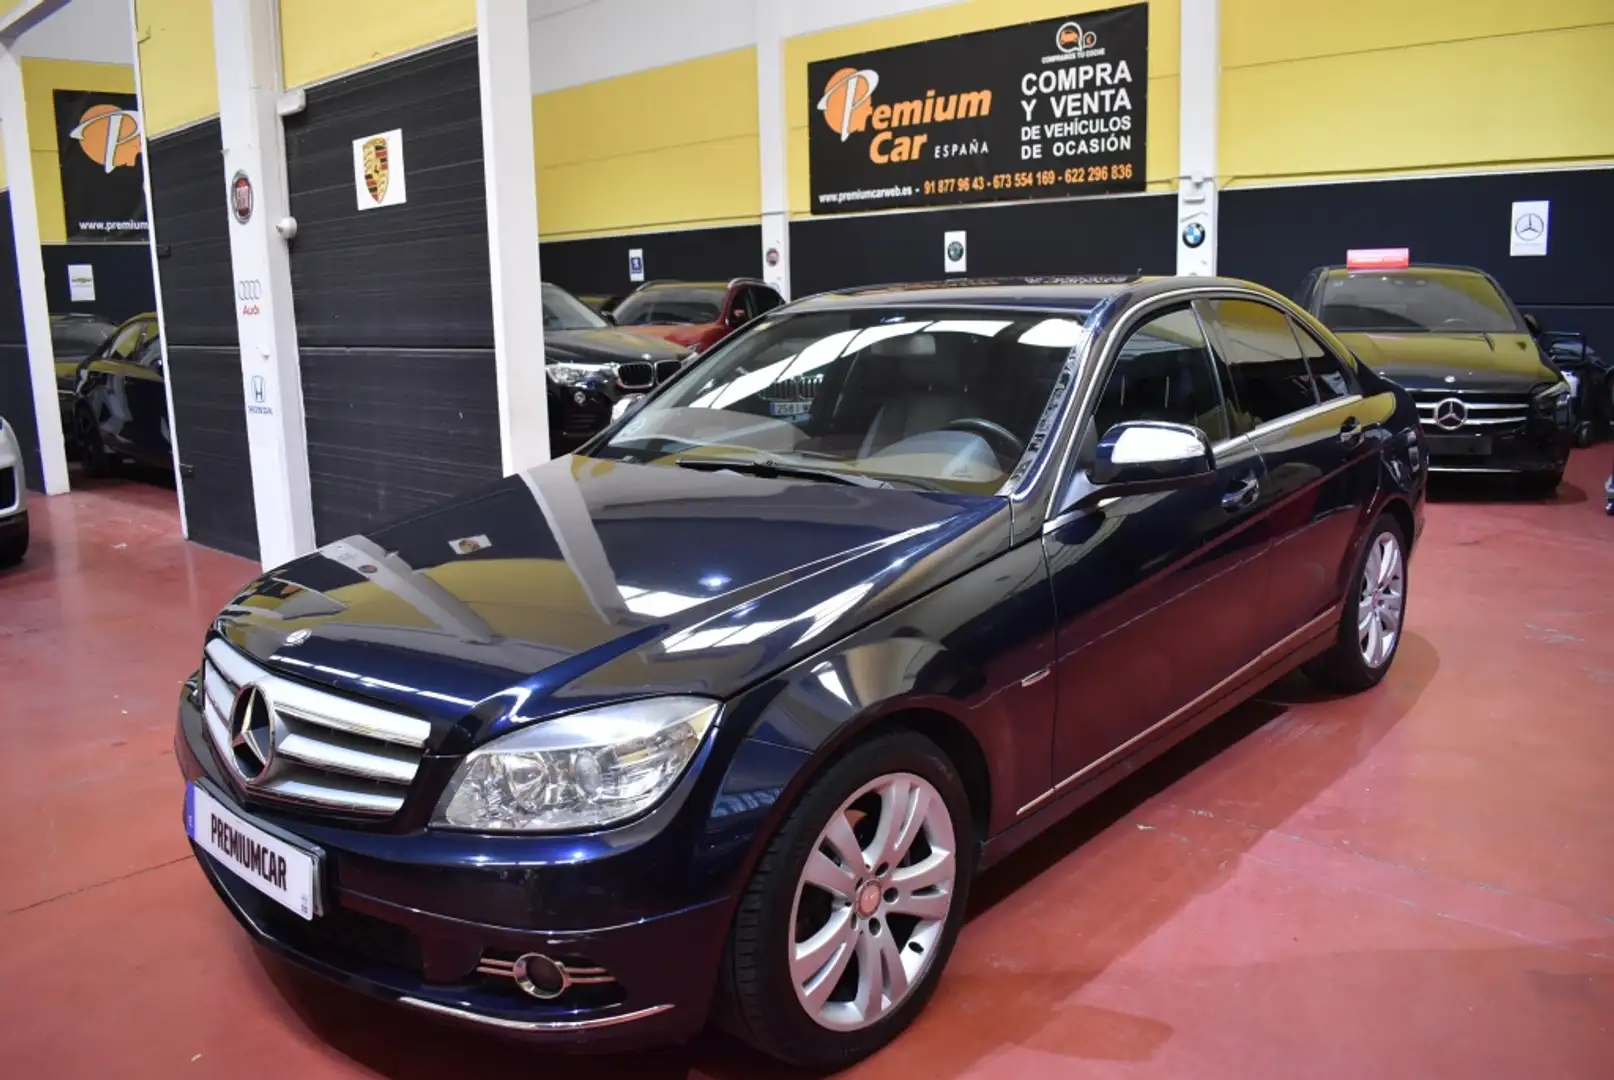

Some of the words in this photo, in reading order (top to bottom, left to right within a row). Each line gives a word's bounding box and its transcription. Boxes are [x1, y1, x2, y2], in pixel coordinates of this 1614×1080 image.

[1021, 60, 1133, 96] COMPRA
[817, 69, 992, 142] Premium
[1020, 98, 1037, 122] Y
[1050, 87, 1132, 118] VENTA
[1021, 125, 1041, 141] DE
[1044, 115, 1132, 138] VEHÍCULOS
[869, 131, 928, 165] Car
[934, 138, 989, 159] ESPAÑA
[1021, 143, 1042, 160] DE
[1052, 133, 1131, 157] OCASIÓN
[818, 185, 912, 204] www.premiumcarweb.es
[923, 180, 936, 195] 91
[938, 178, 955, 193] 877
[971, 175, 985, 190] 43
[992, 173, 1012, 189] 673
[1014, 171, 1033, 187] 554
[1036, 169, 1056, 185] 169
[1064, 167, 1084, 183] 622
[1087, 165, 1108, 182] 296
[1111, 163, 1132, 180] 836
[242, 304, 260, 315] Audi
[210, 813, 287, 891] PREMIUMCAR
